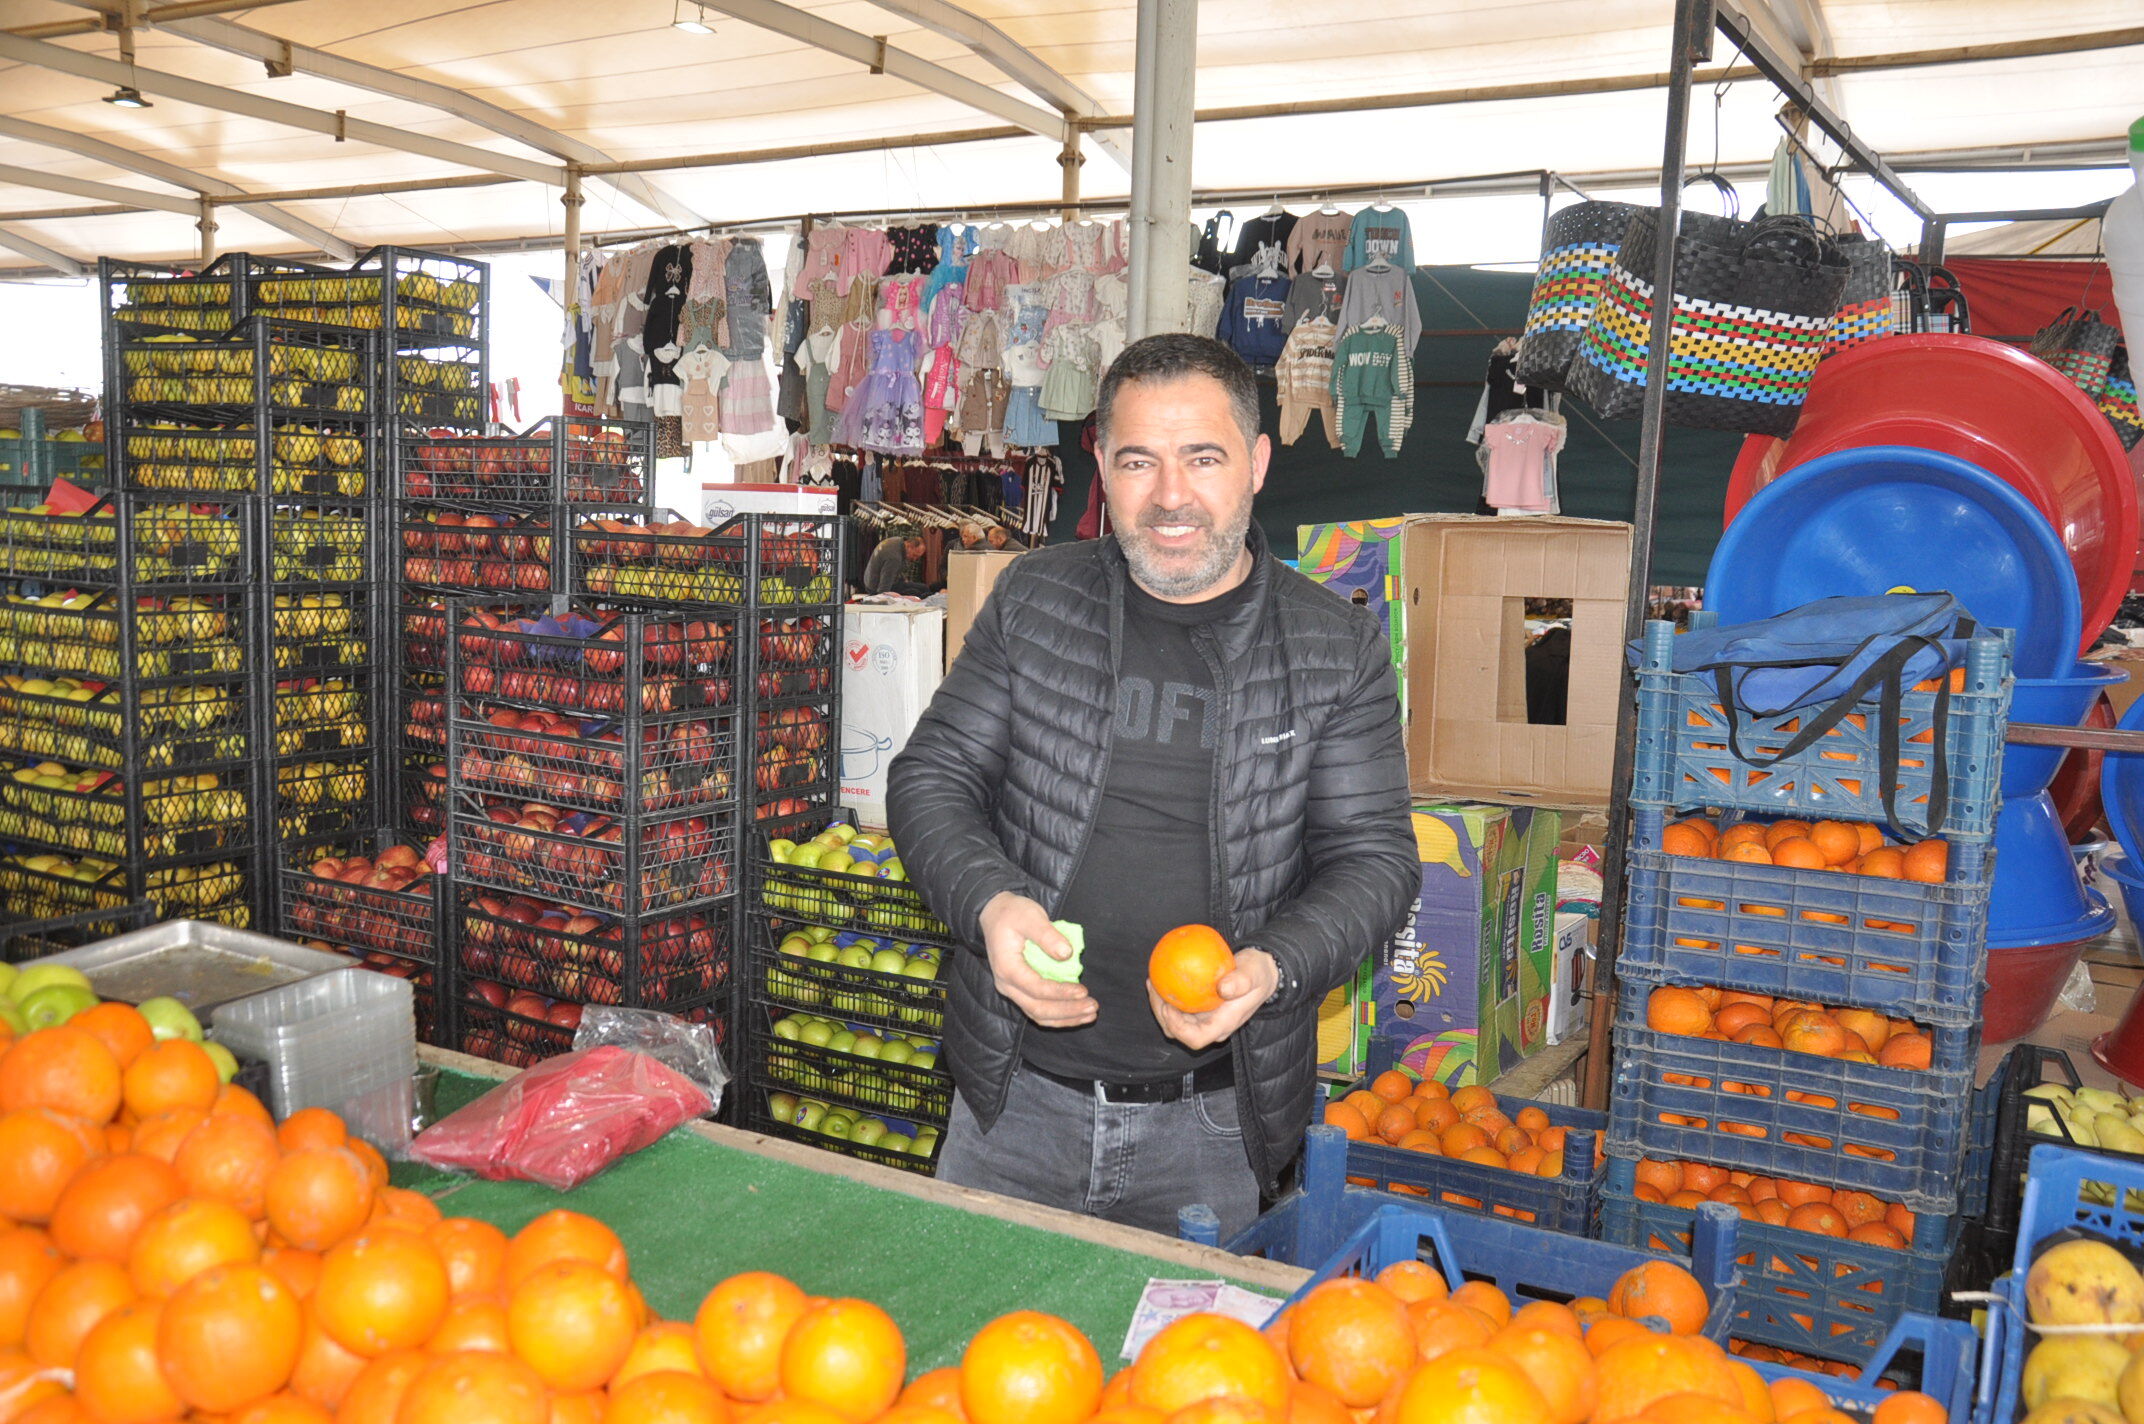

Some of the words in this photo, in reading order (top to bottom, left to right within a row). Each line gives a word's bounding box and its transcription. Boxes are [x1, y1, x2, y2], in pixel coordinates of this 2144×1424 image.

[1365, 239, 1399, 254] DOWN
[1507, 884, 1520, 961] Rosita
[1531, 892, 1546, 953] Rosita
